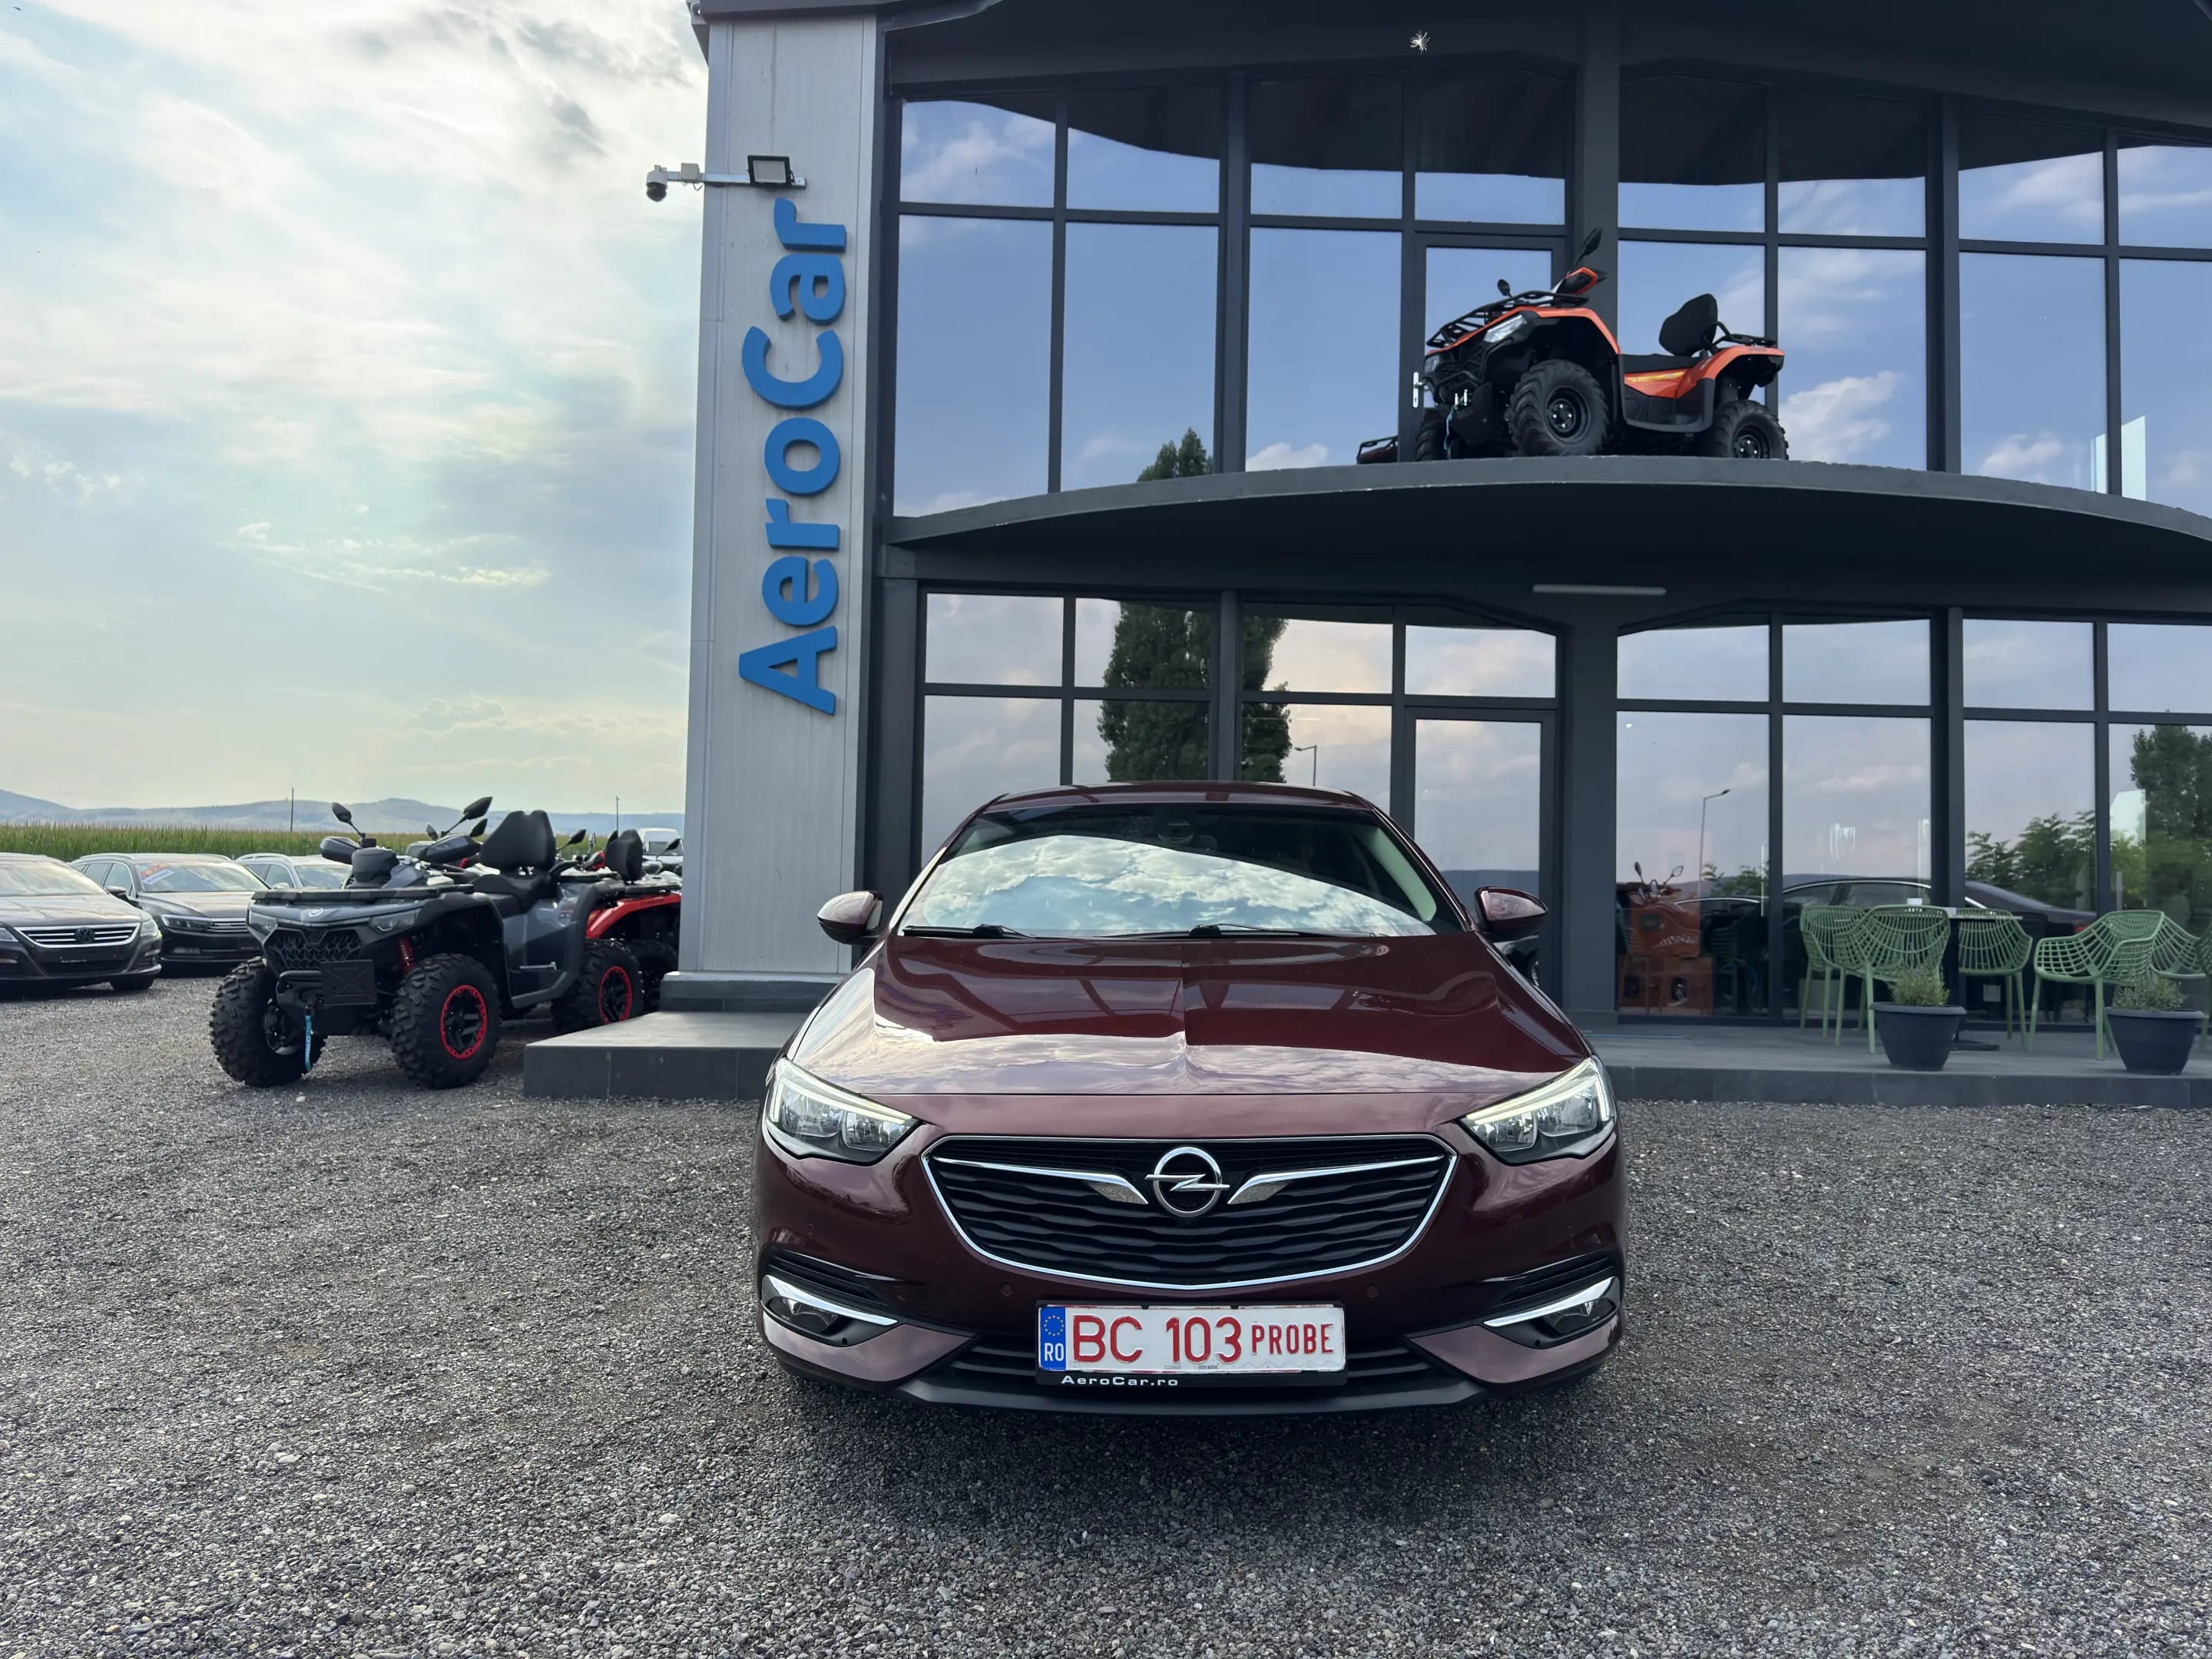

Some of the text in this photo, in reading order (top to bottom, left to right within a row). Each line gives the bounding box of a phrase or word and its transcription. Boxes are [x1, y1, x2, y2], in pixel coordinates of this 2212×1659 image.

[739, 197, 847, 715] AeroCar
[1044, 1343, 1065, 1362] RO
[1073, 1314, 1334, 1364] BC 103 PROBE
[1061, 1375, 1179, 1387] AeroCar.ro
